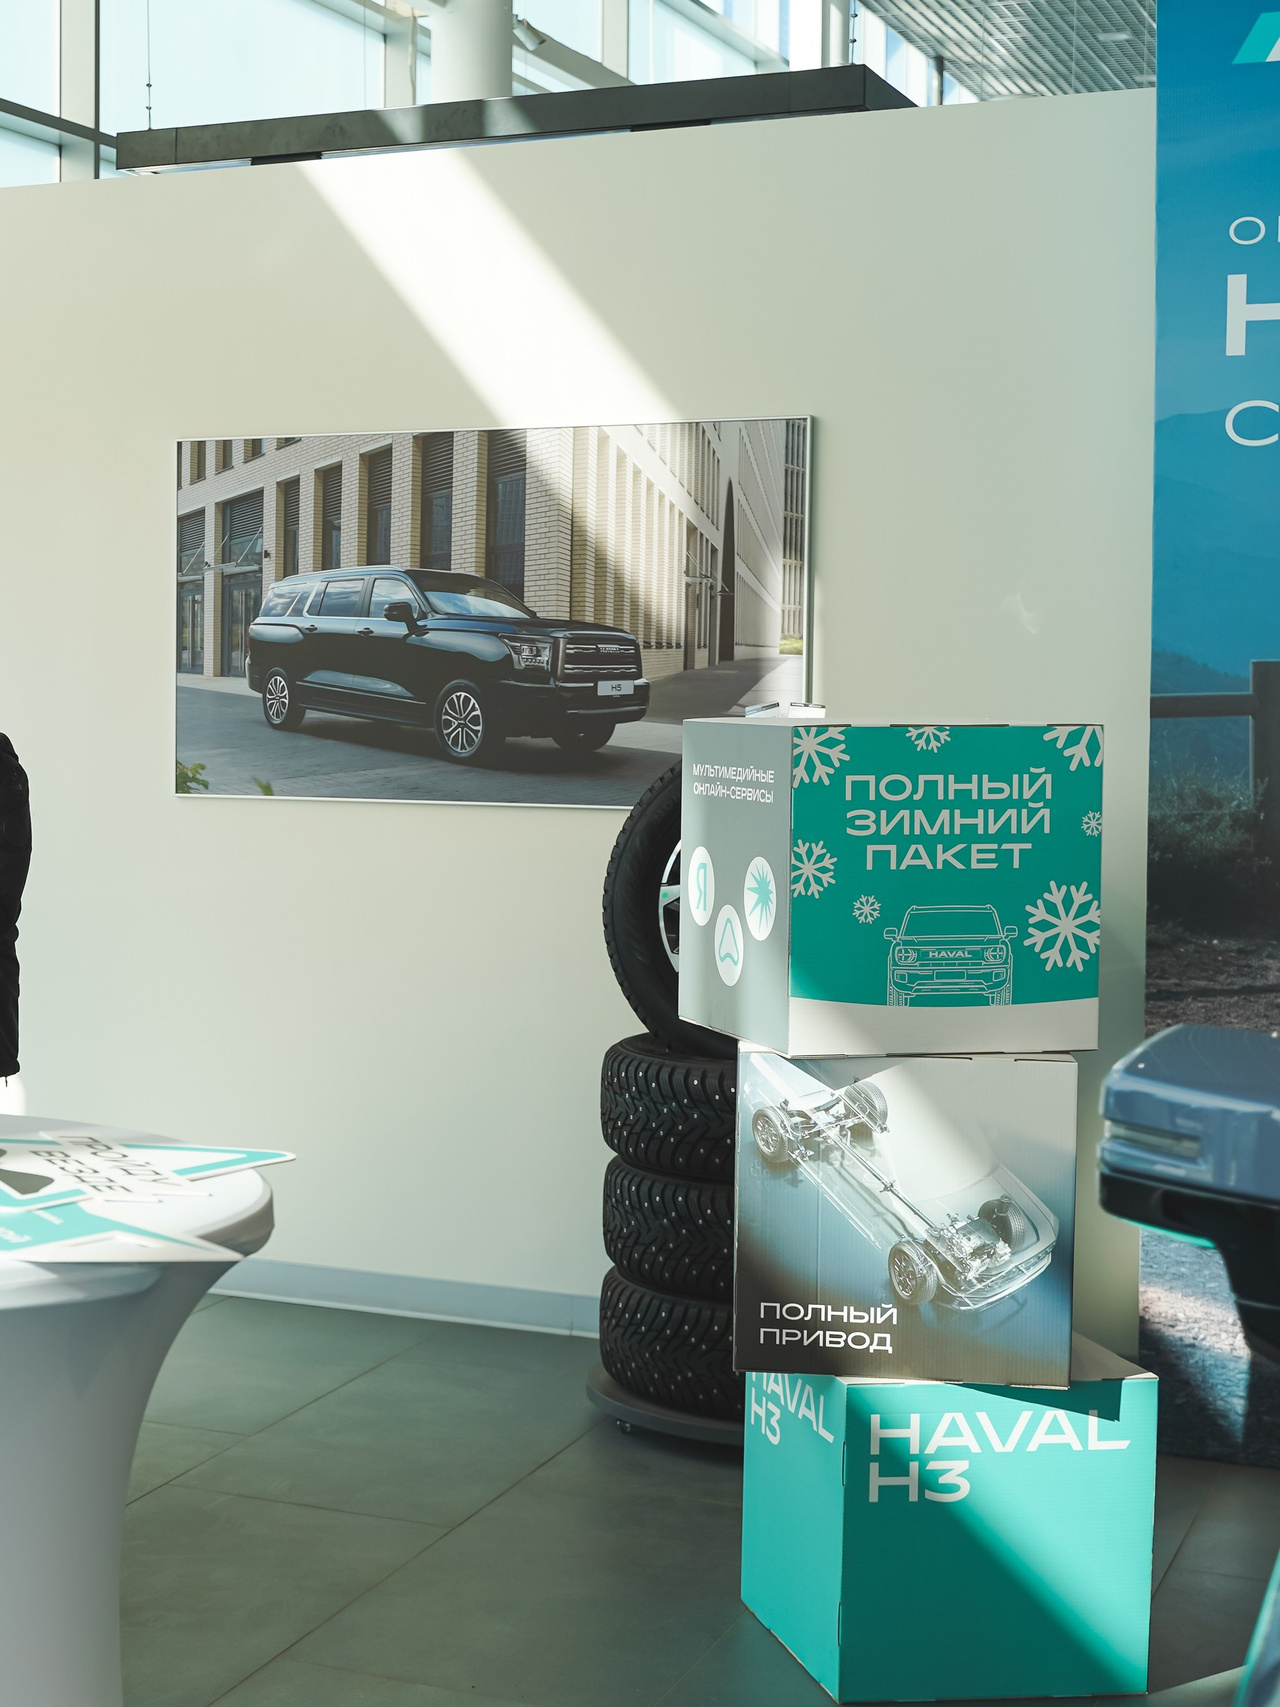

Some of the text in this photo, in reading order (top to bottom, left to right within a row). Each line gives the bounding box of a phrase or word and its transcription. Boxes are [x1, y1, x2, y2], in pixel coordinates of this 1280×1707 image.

[692, 763, 775, 783] МУЛЬТИМЕДИЙНЫЕ
[845, 766, 1053, 801] ПОЛНЫЙ
[693, 781, 774, 803] ОНЛАЙН-СЕРВИСЫ
[846, 801, 1051, 836] ЗИМНИЙ
[866, 843, 1033, 870] ПАКЕТ
[928, 950, 973, 958] HAVAL
[29, 1150, 134, 1193] ВЕЗДЕ
[58, 1135, 183, 1187] ПРОЙДУ
[760, 1302, 898, 1325] ПОЛНЫЙ
[759, 1328, 893, 1354] ПРИВОД
[750, 1386, 781, 1446] H3
[870, 1409, 1132, 1456] HAVAL
[868, 1459, 971, 1503] H3
